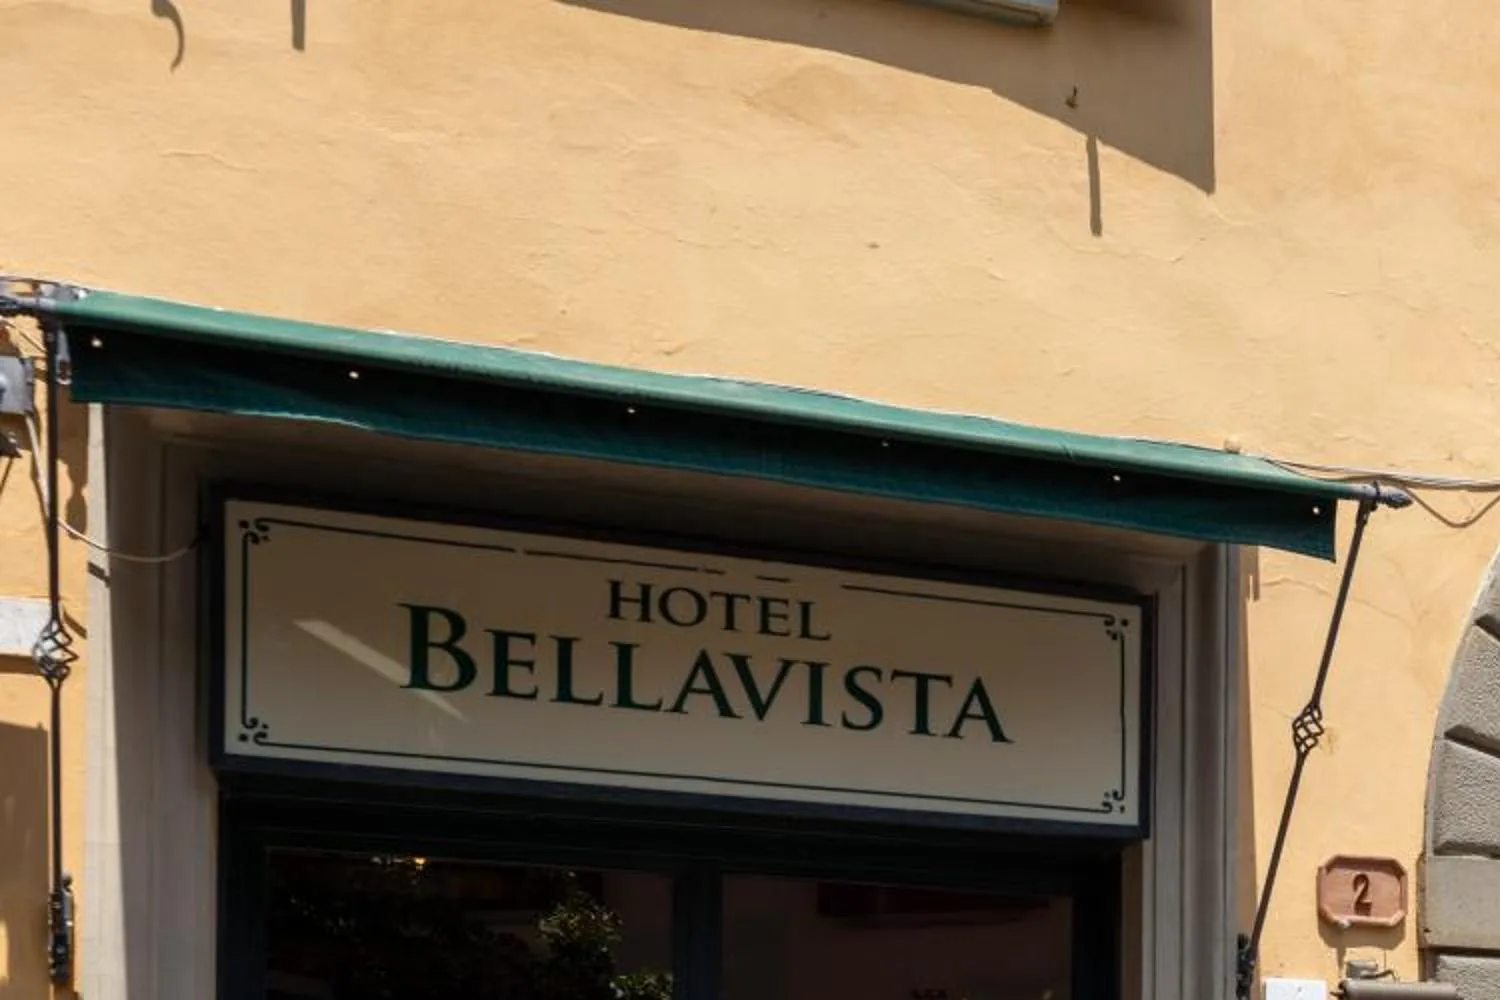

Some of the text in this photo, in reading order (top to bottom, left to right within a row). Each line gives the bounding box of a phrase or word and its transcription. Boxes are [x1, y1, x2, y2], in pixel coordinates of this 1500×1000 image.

[608, 579, 832, 641] HOTEL
[399, 602, 1014, 744] BELLAVISTA
[1352, 873, 1373, 917] 2
